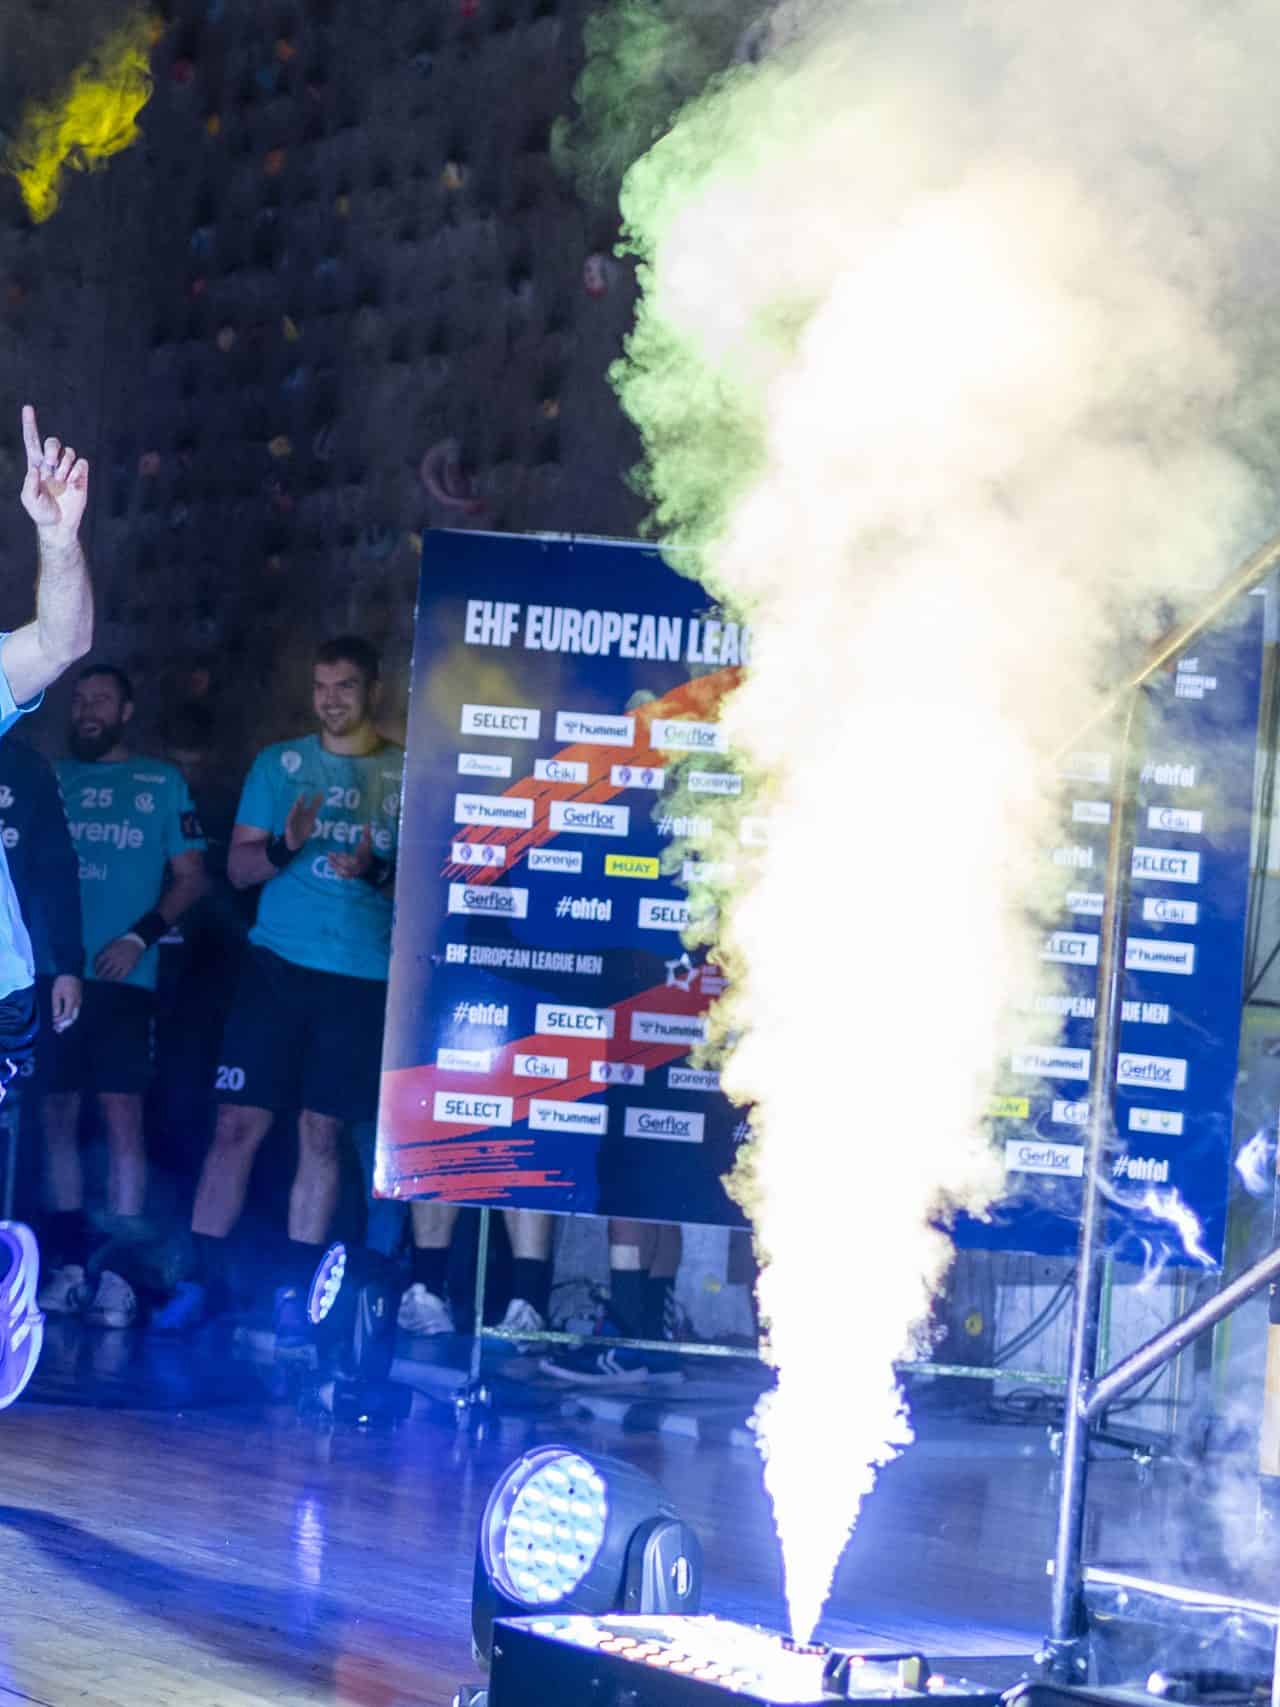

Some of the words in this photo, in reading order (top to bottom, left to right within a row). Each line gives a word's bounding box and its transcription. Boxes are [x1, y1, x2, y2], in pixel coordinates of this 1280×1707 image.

[464, 599, 521, 648] EHF
[524, 604, 683, 662] EUROPEAN
[472, 711, 529, 732] SELECT
[579, 721, 628, 738] hummel
[80, 787, 114, 809] 25
[325, 786, 361, 809] 20
[479, 803, 527, 819] hummel
[563, 808, 616, 828] Gerflor
[531, 852, 580, 868] gorenje
[612, 860, 651, 873] MUAY
[1133, 854, 1188, 874] SELECT
[463, 889, 515, 911] Gerflor
[556, 896, 613, 921] #ehfel
[1051, 939, 1087, 957] LECT
[1139, 948, 1187, 964] hummel
[445, 943, 469, 964] EHF
[469, 945, 531, 968] EUROPEAN
[532, 949, 576, 972] LEAGUE
[576, 954, 604, 975] MEN
[453, 1001, 509, 1027] #ehfel
[547, 1011, 604, 1031] SELECT
[1142, 1002, 1169, 1024] MEN
[655, 1021, 704, 1039] hummel
[214, 1065, 246, 1091] 20
[671, 1071, 720, 1087] gorenje
[1121, 1058, 1172, 1081] Gerflor
[445, 1099, 502, 1119] SELECT
[552, 1110, 601, 1126] hummel
[638, 1113, 692, 1136] Gerflor
[1018, 1146, 1071, 1168] Gerflor
[1112, 1155, 1170, 1183] #ehfel
